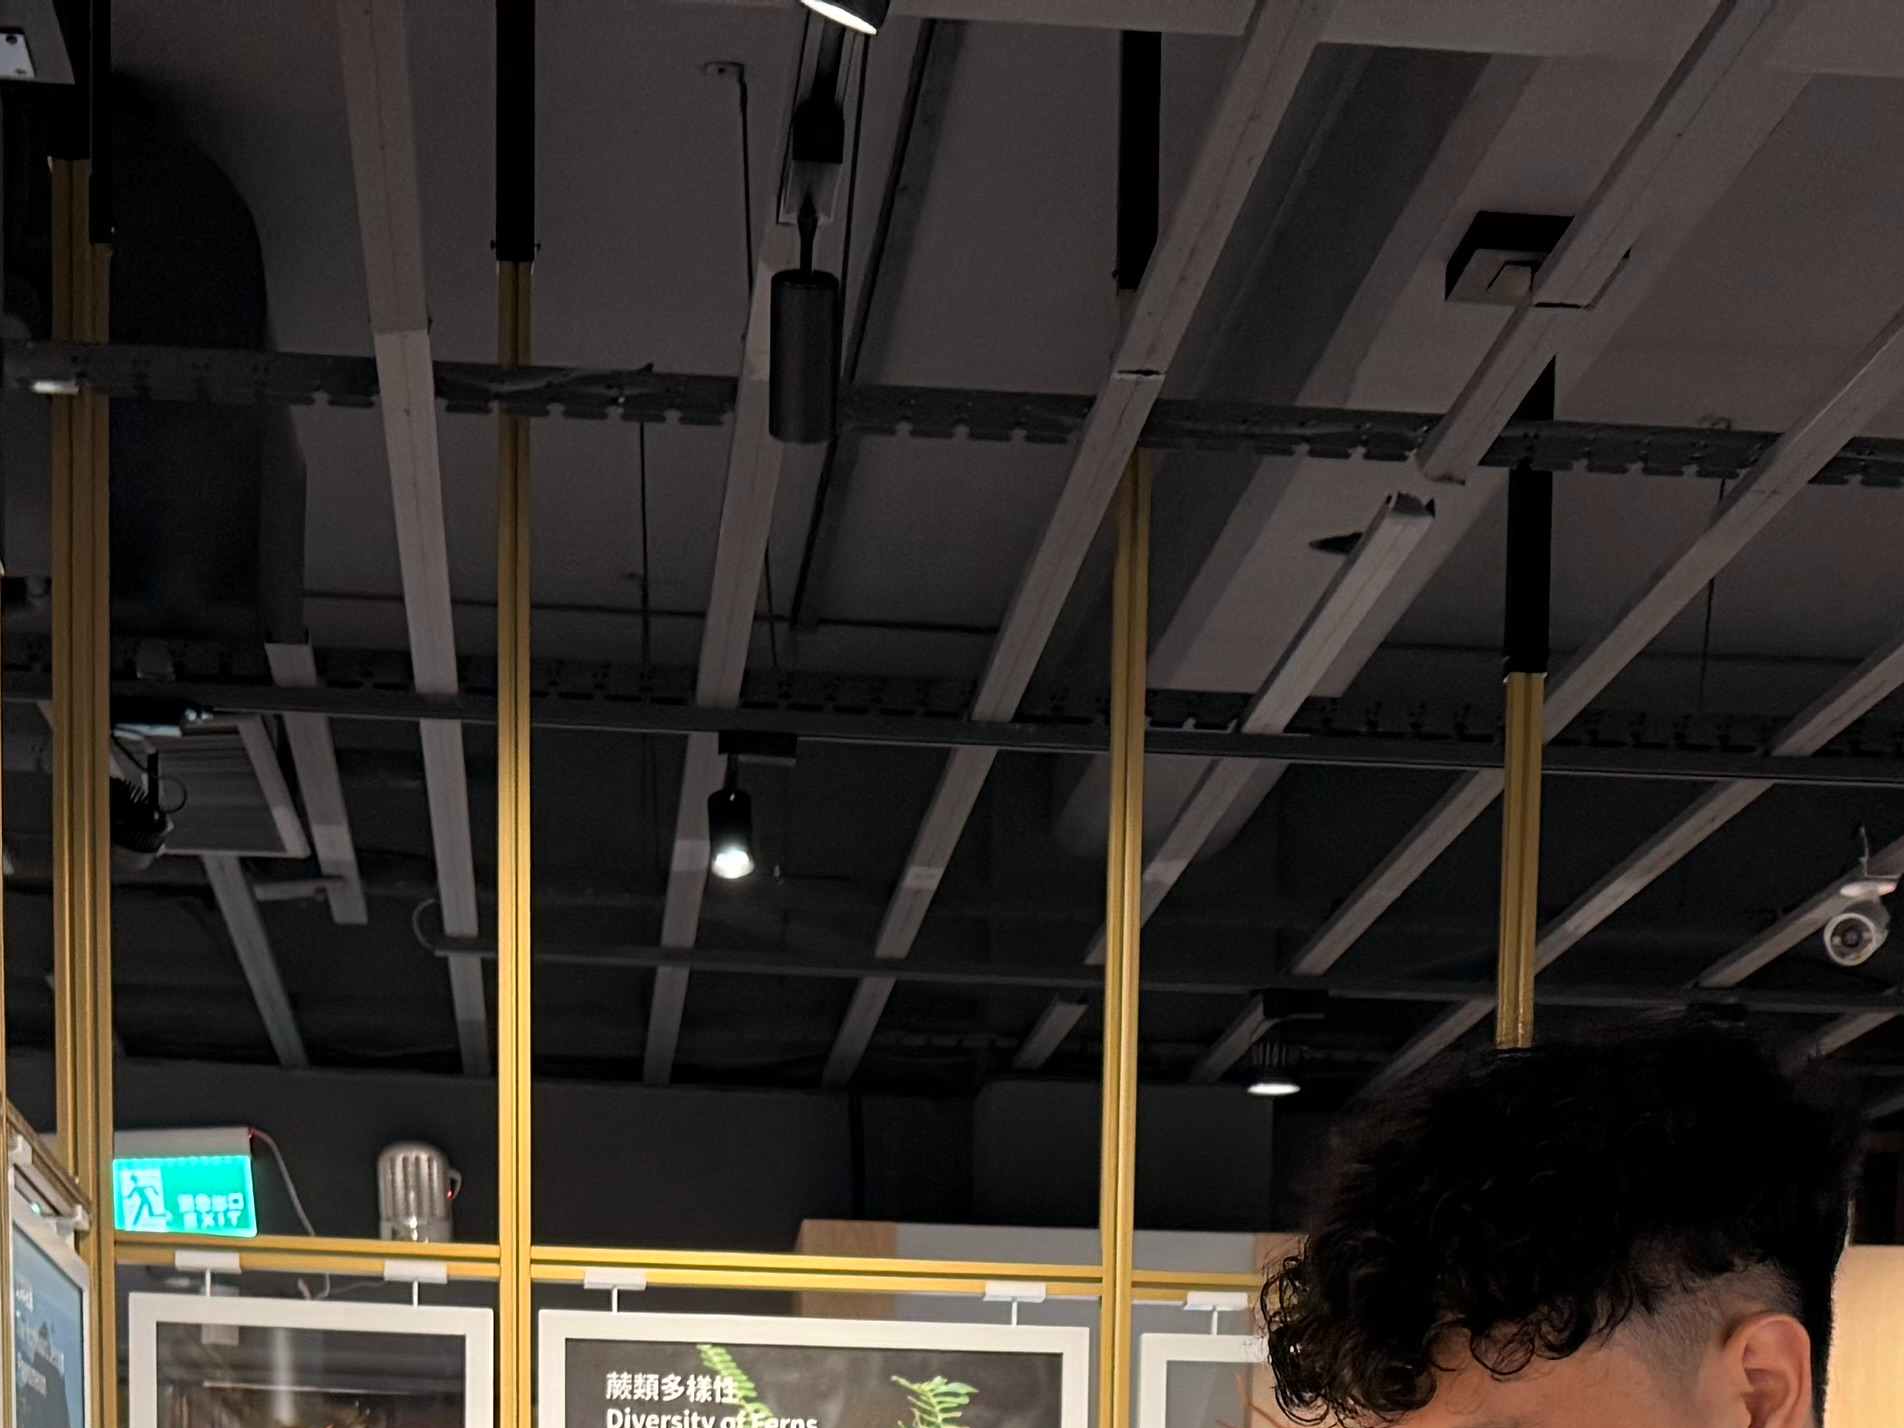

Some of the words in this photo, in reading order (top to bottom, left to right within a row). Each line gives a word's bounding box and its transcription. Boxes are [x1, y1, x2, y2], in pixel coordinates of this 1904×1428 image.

[183, 1210, 243, 1229] EXIT
[606, 1372, 739, 1402] 蕨類多樣性
